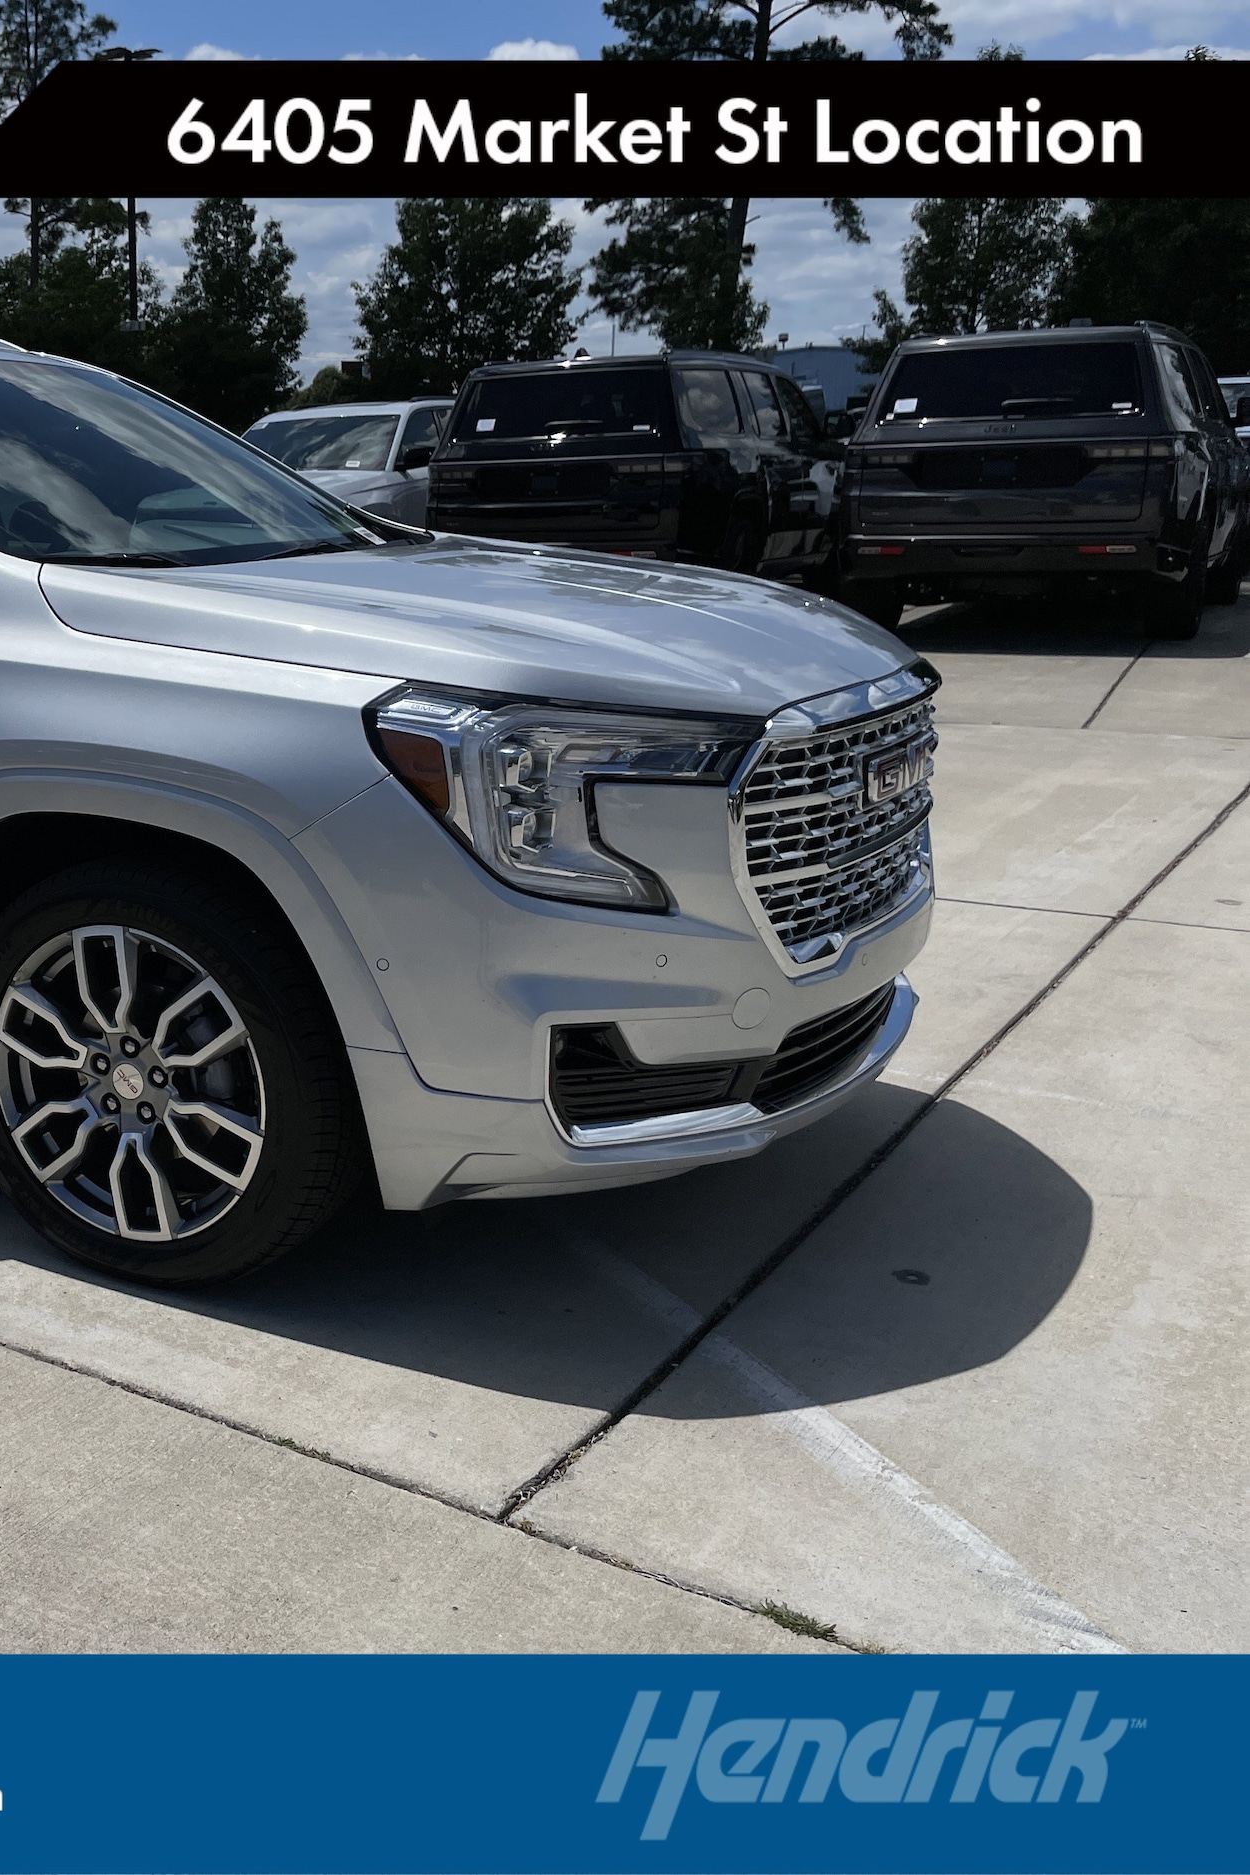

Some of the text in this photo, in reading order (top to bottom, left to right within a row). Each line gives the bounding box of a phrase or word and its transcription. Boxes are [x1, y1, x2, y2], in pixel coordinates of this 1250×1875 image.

[410, 703, 442, 714] GMC
[868, 731, 934, 803] GMC
[117, 1069, 138, 1094] GMC
